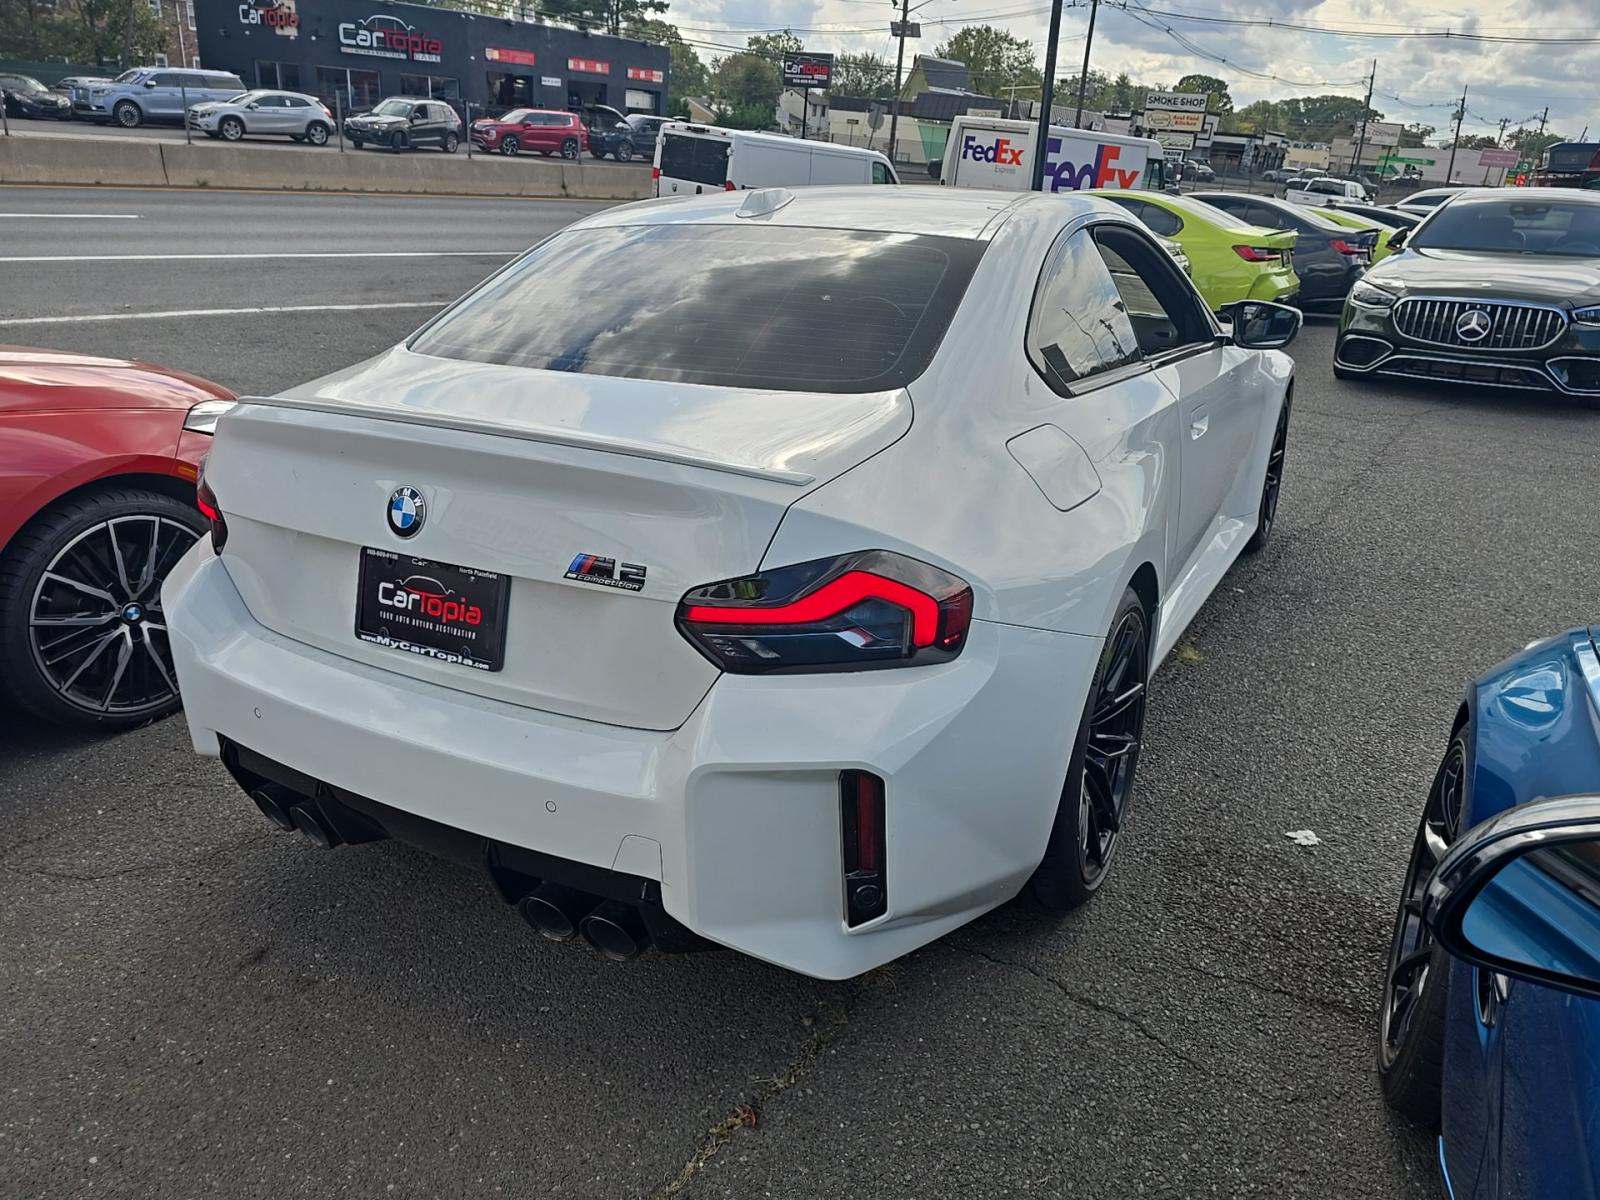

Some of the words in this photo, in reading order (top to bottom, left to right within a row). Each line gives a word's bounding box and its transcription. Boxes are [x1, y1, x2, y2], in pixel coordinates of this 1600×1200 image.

[338, 23, 442, 60] CarTopia
[1148, 95, 1179, 106] SMOKE
[1180, 98, 1206, 107] SHOP
[962, 136, 1024, 166] FedEx
[378, 582, 482, 624] CarTopia
[360, 634, 490, 671] www.MyCarTopia.com
